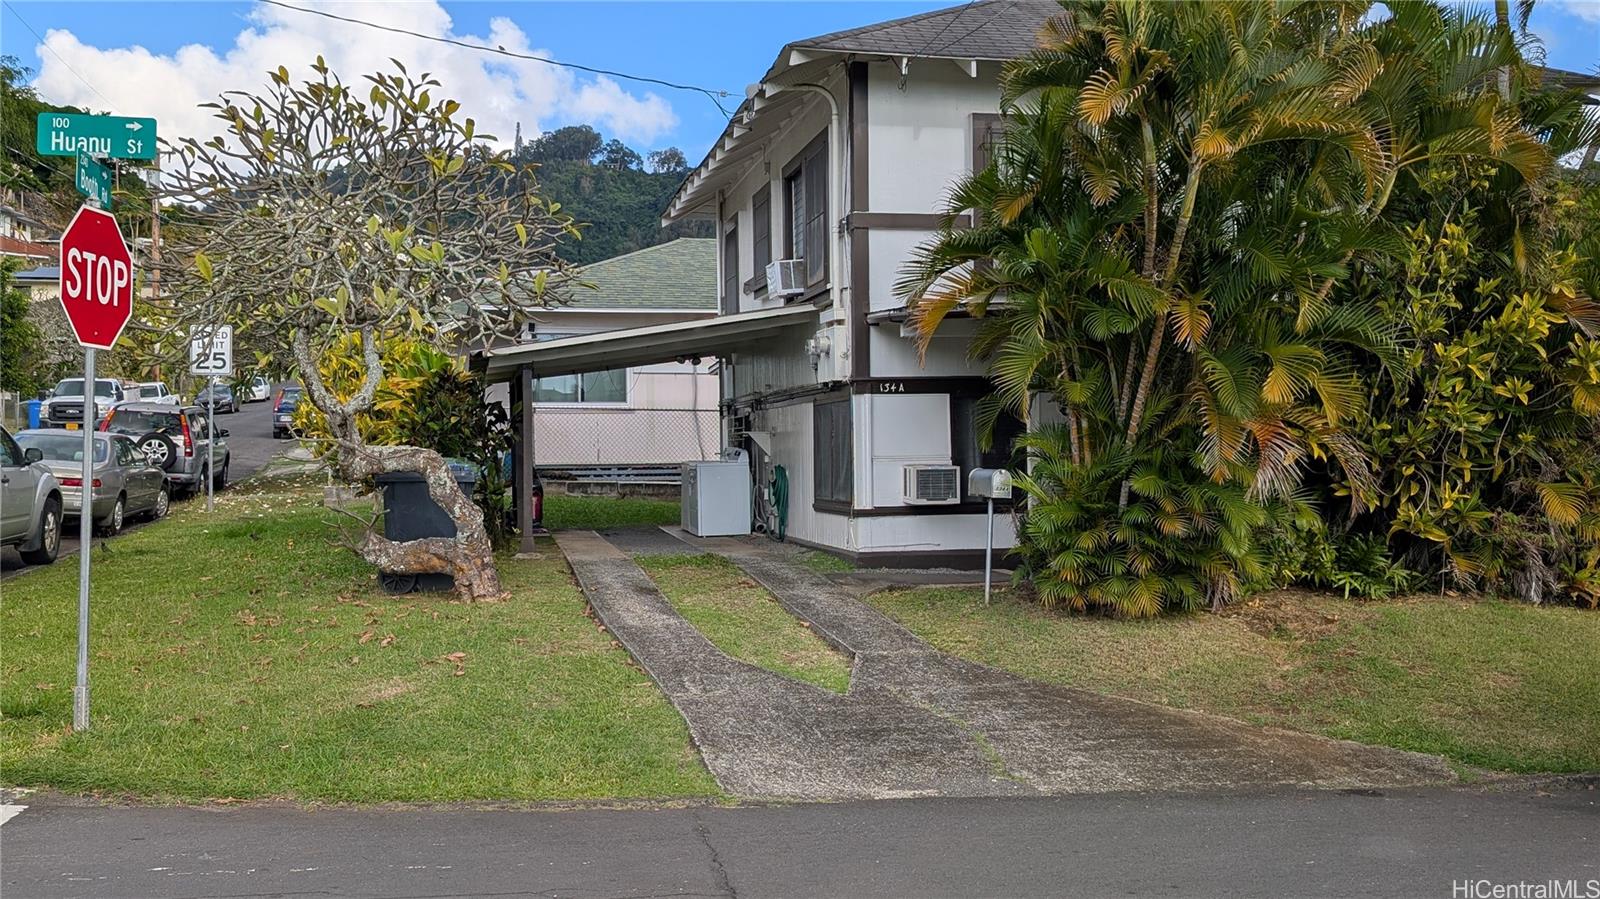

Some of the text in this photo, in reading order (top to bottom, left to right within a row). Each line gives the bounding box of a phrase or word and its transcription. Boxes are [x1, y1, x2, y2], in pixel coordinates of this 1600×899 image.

[52, 117, 70, 129] 100
[51, 131, 143, 154] Huanu St
[66, 247, 128, 307] STOP
[196, 352, 226, 370] 25
